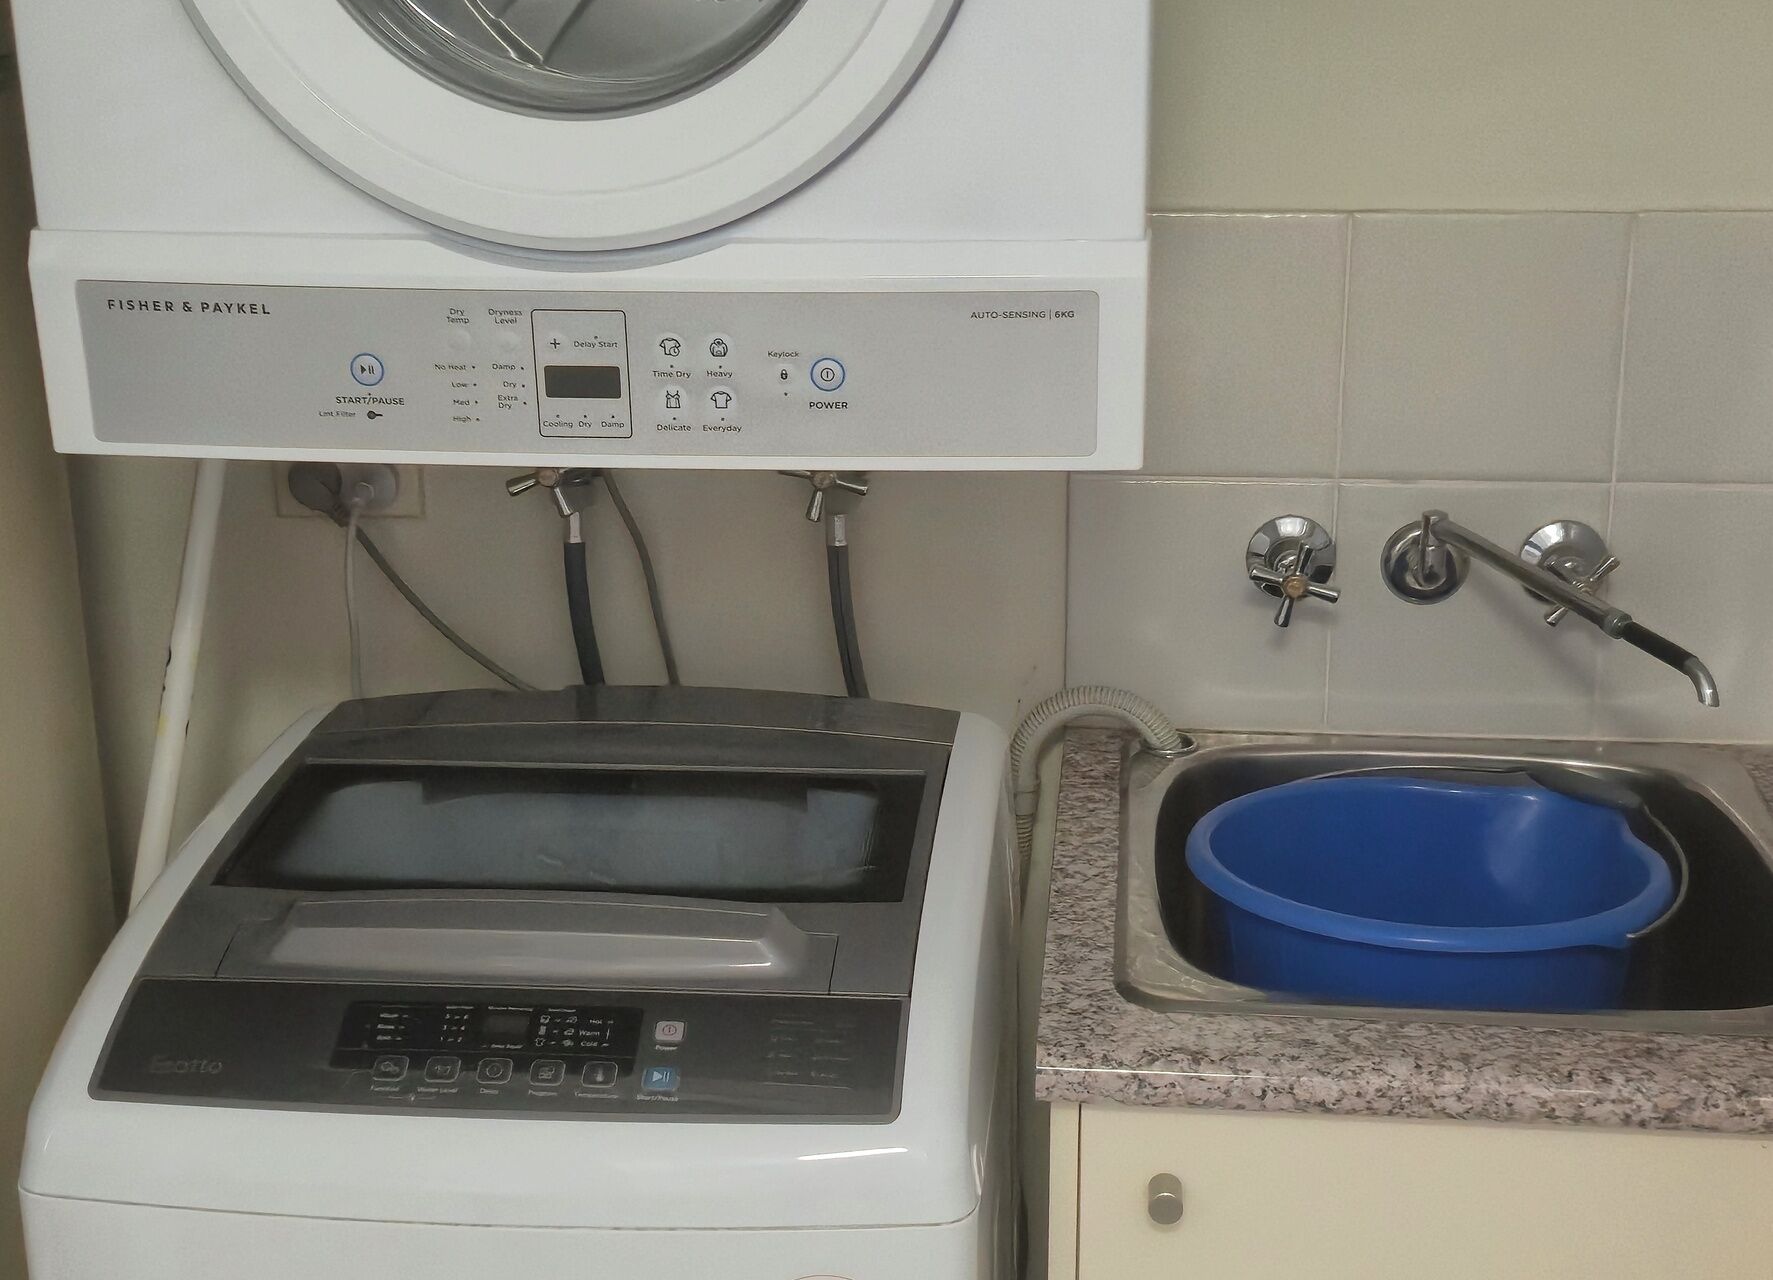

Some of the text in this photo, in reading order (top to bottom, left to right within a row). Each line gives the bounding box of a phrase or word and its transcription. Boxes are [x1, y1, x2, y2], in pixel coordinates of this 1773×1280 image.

[107, 299, 271, 315] FISHER & PAYKEL
[449, 308, 465, 317] Dry
[487, 308, 523, 317] Dryness
[970, 310, 1075, 319] AUTO-SENSING 6KG
[446, 316, 470, 325] Temp
[494, 317, 518, 325] Level
[573, 341, 597, 349] Delay
[767, 350, 800, 358] Keylock
[434, 363, 446, 371] No
[491, 363, 516, 371] Damp
[652, 370, 692, 379] Time Dry
[706, 370, 733, 378] Heavy
[502, 381, 517, 389] Dry
[335, 396, 405, 406] START/PAUSE
[809, 401, 848, 410] POWER
[498, 402, 512, 410] Dry
[542, 420, 574, 429] Cooling
[578, 420, 593, 429] Dry
[600, 420, 625, 429] Damp
[656, 424, 692, 432] Delicate
[702, 424, 742, 433] Everyday
